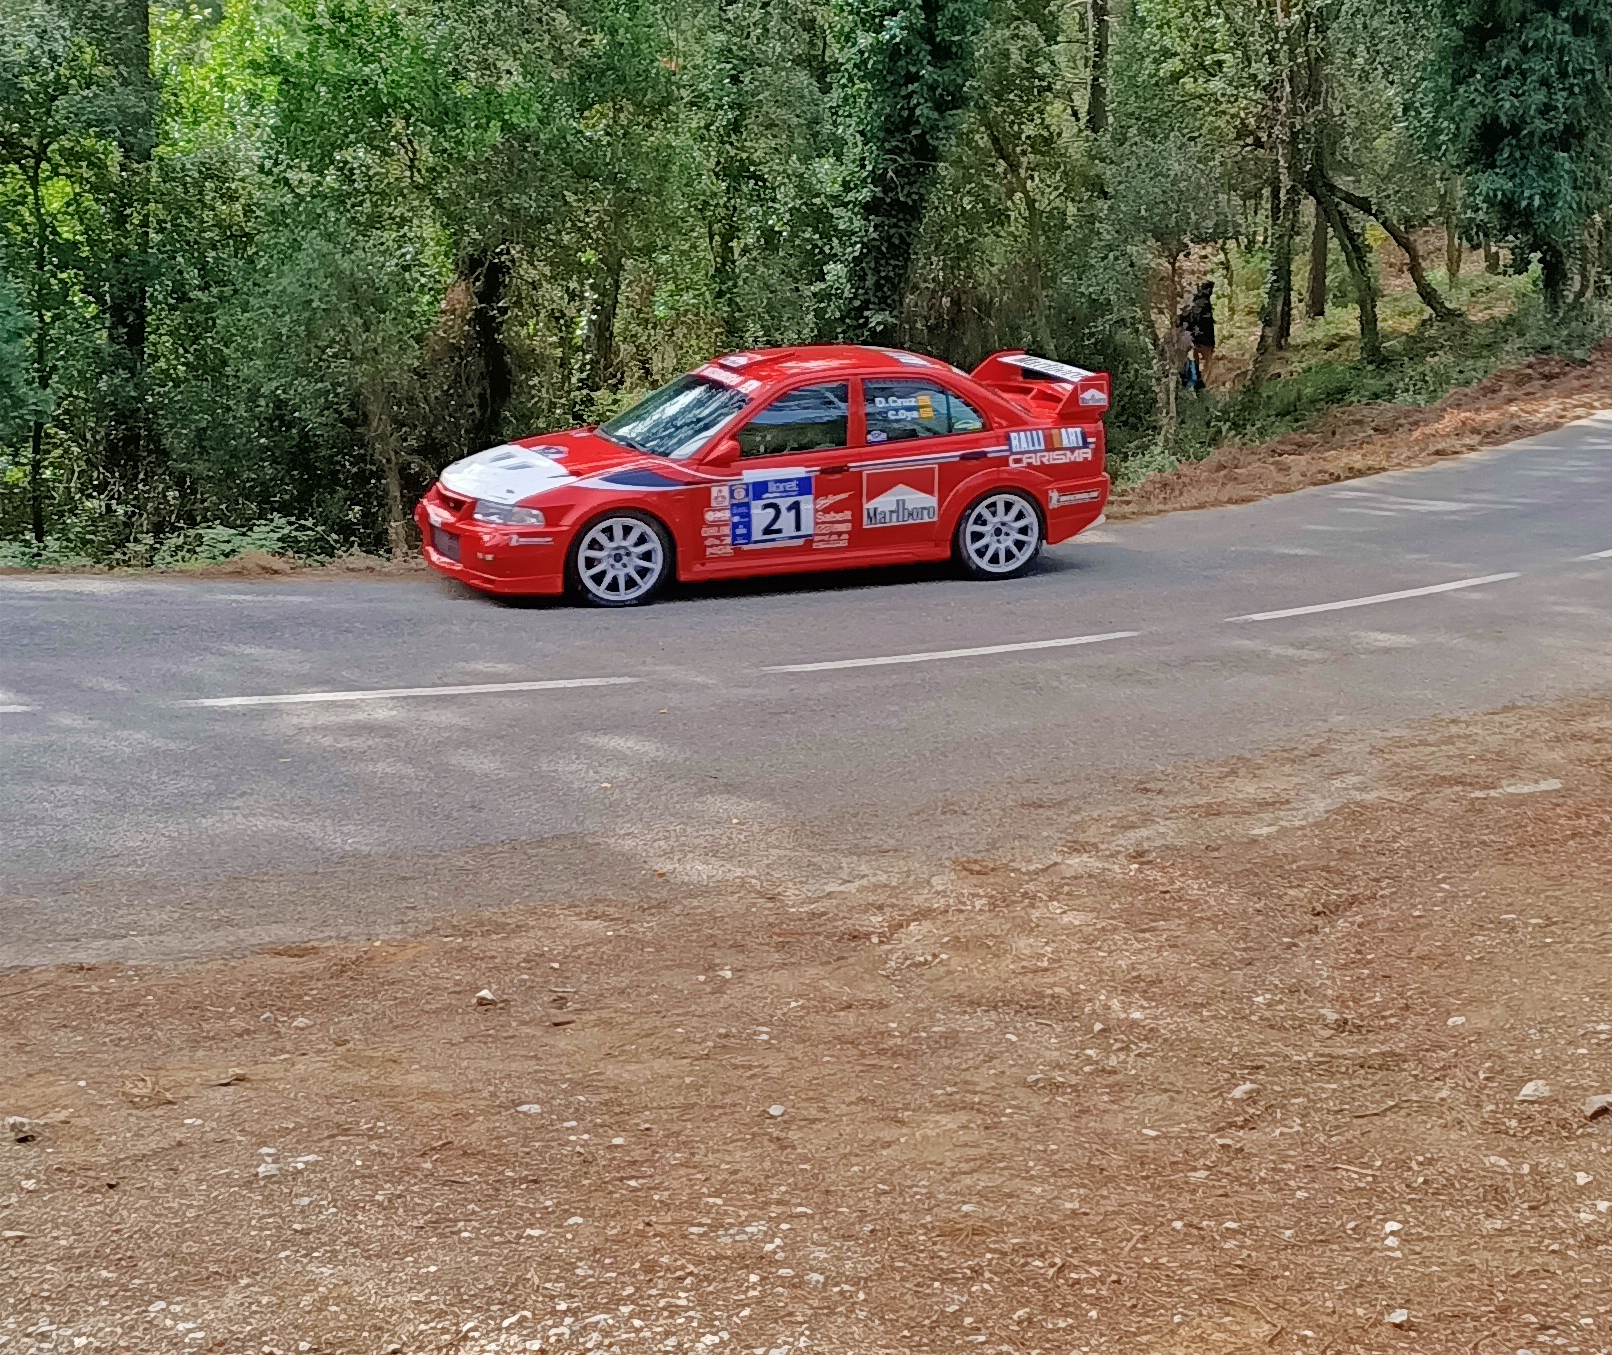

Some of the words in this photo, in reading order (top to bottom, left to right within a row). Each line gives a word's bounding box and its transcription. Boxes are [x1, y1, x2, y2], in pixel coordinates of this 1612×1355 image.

[1009, 449, 1092, 468] CARISMA
[761, 500, 802, 536] 21
[865, 499, 936, 527] Marlboro
